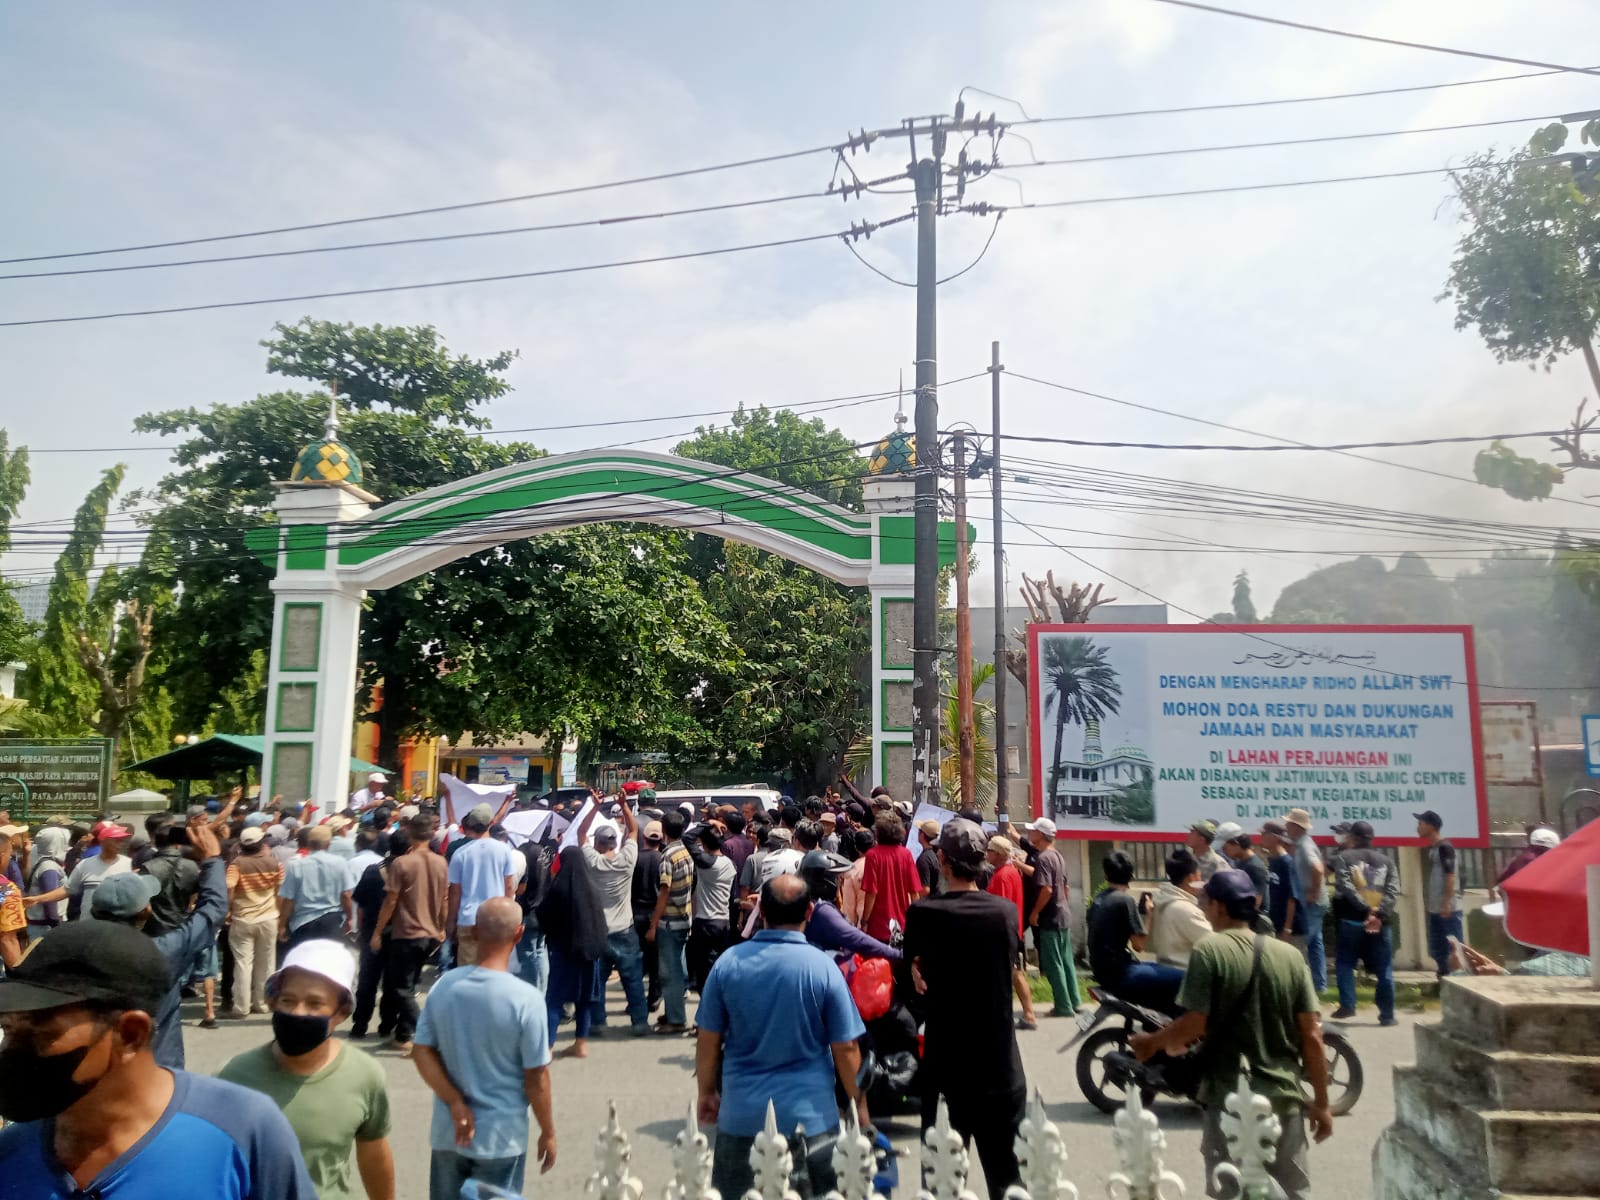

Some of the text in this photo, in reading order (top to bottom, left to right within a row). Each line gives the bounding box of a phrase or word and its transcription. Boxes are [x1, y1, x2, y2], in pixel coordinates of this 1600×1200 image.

[1159, 674, 1453, 690] DENGAN MENGHARAP RIDHO ALLAH SWT
[1163, 702, 1454, 719] MOHON DOA RESTU DAN DUKUNGAN
[1199, 722, 1419, 739] JAMAAH DAN MASYARAKAT
[20, 755, 60, 764] PERSATUAN
[61, 755, 100, 764] JATIMULYA
[1209, 749, 1413, 767] DI LAHAN PERJUANGAN INI
[44, 772, 60, 780] RAYA
[62, 772, 98, 780] JATIMULYA
[1159, 767, 1467, 786] AKAN DIBANGUN JATIMULYA ISLAMIC CENTRE
[32, 792, 51, 801] RAYA
[53, 792, 97, 801] JATIMULYA
[1201, 785, 1426, 802] SEBAGAI PUSAT KEGIATAN ISLAM
[1236, 804, 1250, 817] DI
[1342, 806, 1393, 820] BEKASI
